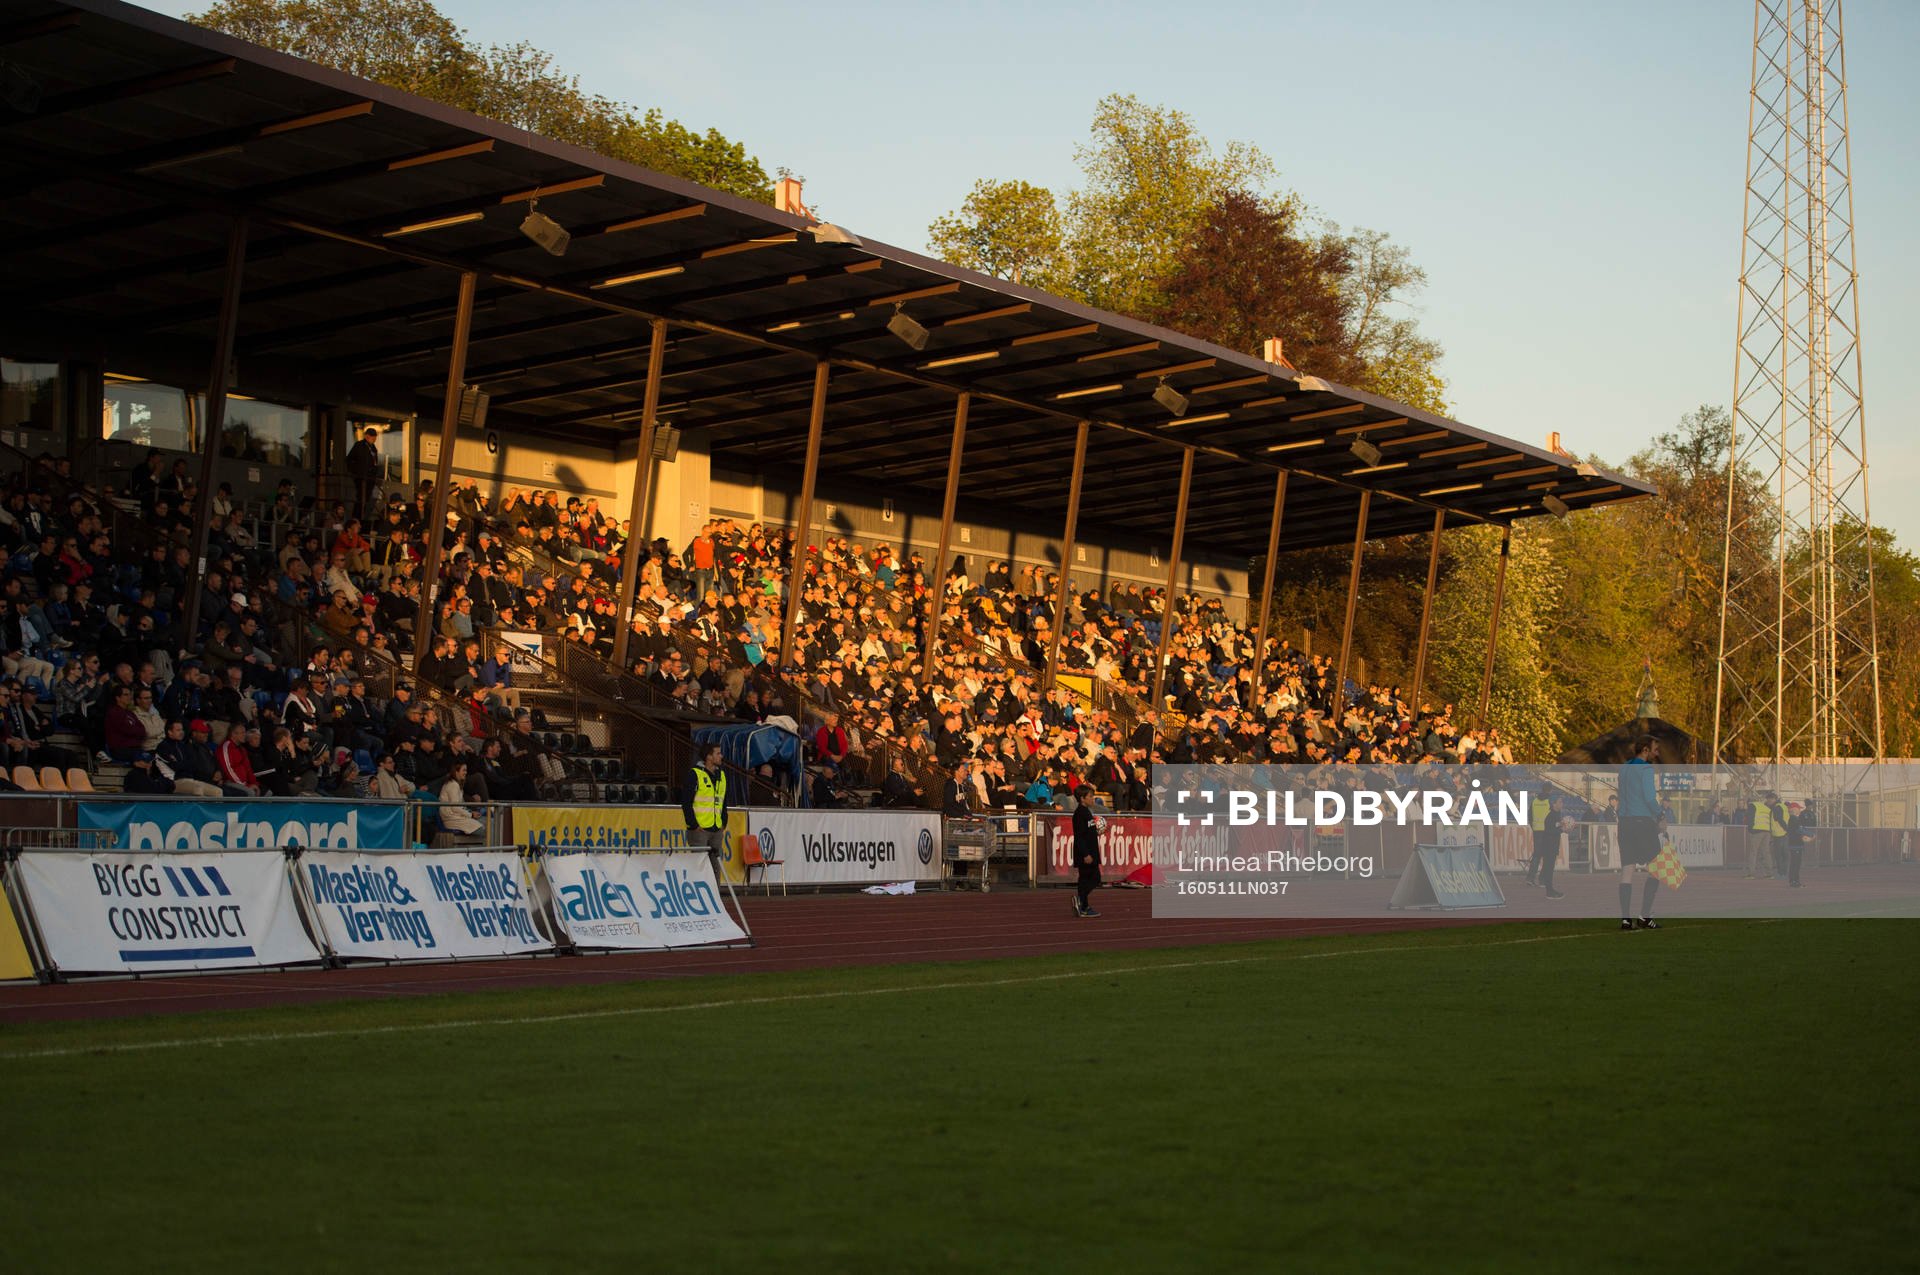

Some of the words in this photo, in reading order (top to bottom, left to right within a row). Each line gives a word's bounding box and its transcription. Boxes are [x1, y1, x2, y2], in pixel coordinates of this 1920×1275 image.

[487, 432, 498, 454] G
[802, 833, 896, 869] Volkswagen
[1109, 825, 1132, 866] för
[1133, 825, 1178, 865] svensk
[92, 863, 162, 898] BYGG
[640, 869, 721, 919] Sallén
[108, 905, 247, 940] CONSTRUCT
[337, 904, 436, 948] Verktyg
[456, 901, 539, 944] Verktyg
